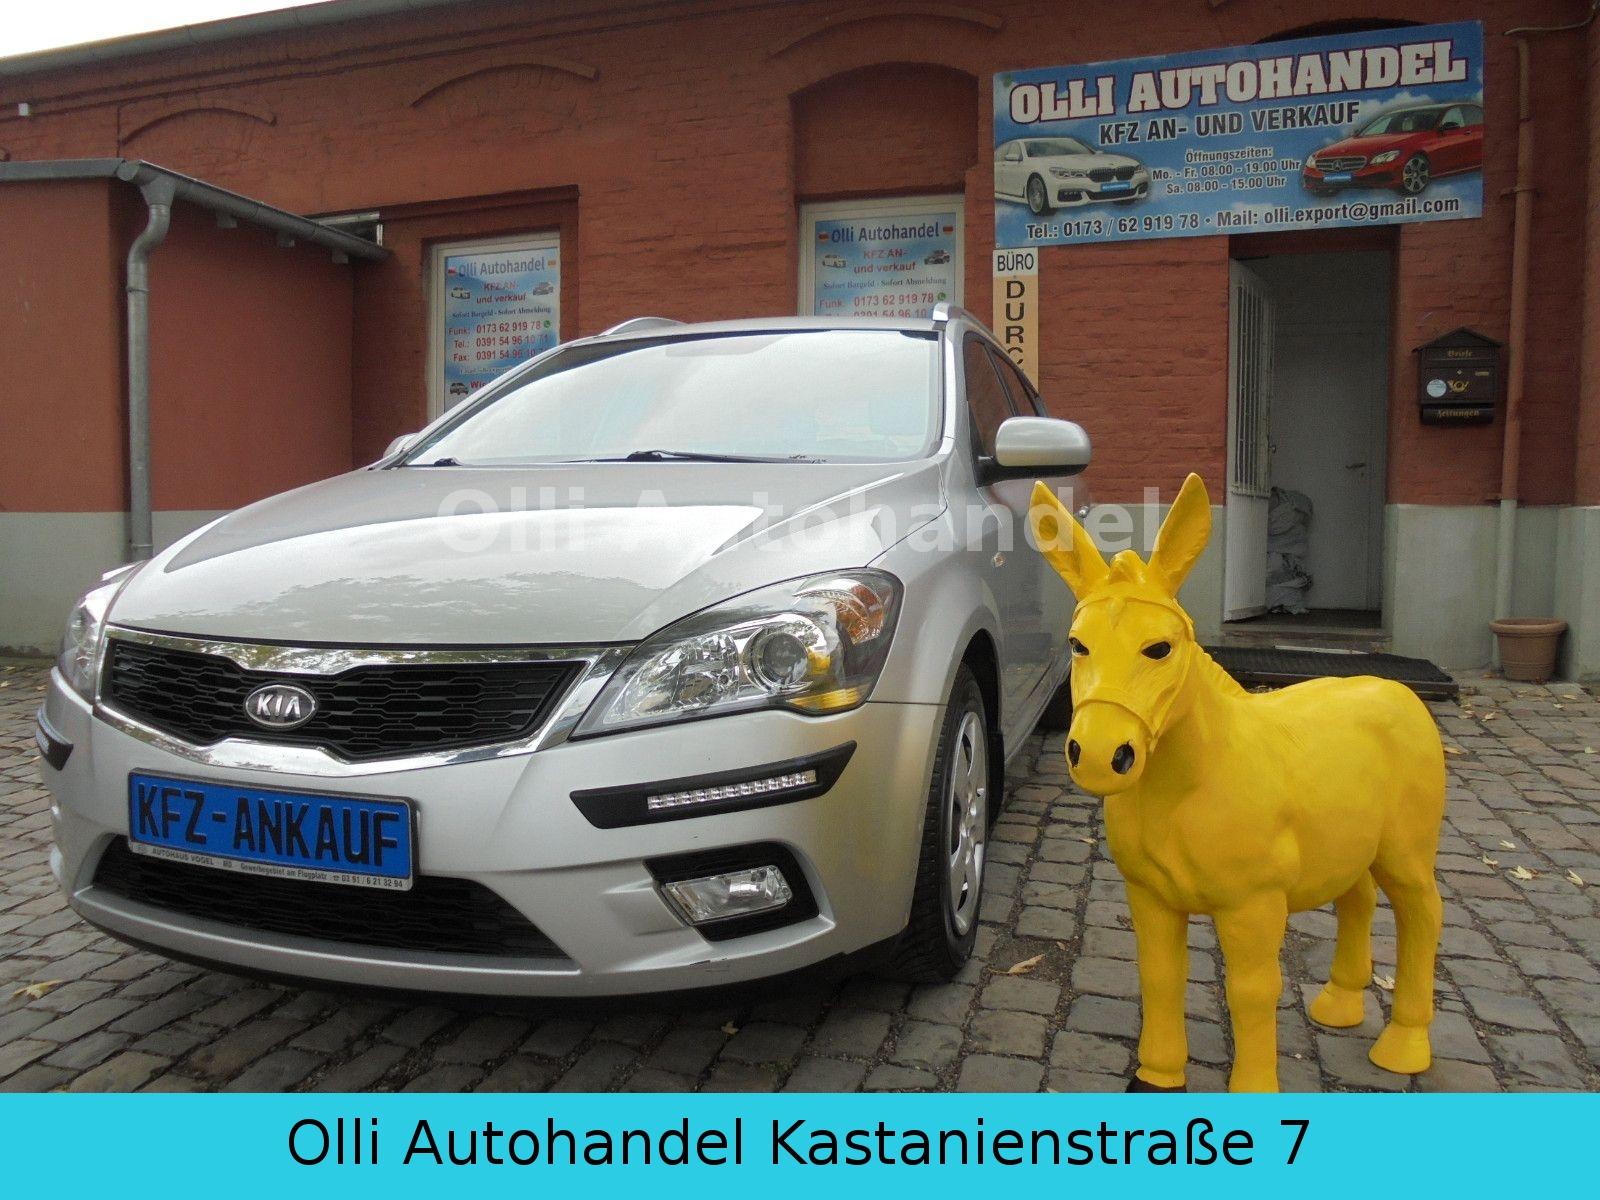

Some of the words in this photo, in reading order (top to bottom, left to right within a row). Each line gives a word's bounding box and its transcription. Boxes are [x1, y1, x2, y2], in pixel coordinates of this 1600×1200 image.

[1009, 72, 1114, 125] OLLI
[1127, 40, 1467, 113] AUTOHANDEL
[1099, 121, 1139, 145] KFZ
[1147, 117, 1188, 142] AN-
[1195, 113, 1243, 138] UND
[1251, 101, 1360, 133] VERKAUF
[1186, 147, 1273, 163] Öffnungszeiten:
[1152, 169, 1173, 180] Mo.
[1184, 167, 1197, 178] Fr.
[1201, 164, 1232, 177] 08.00
[1246, 160, 1277, 173] 19.00
[1281, 159, 1300, 170] Uhr
[1187, 180, 1218, 193] 08.00
[1231, 178, 1262, 190] 15.00
[1266, 176, 1286, 187] Uhr
[1026, 224, 1059, 240] Tel.:
[1063, 220, 1102, 238] 0173
[1105, 220, 1114, 237] /
[1118, 218, 1138, 234] 62
[1143, 216, 1174, 232] 919
[1179, 214, 1199, 230] 78
[1217, 209, 1258, 228] Mail:
[1264, 197, 1460, 225] olli.export@gmail.com
[831, 226, 854, 243] Olli
[858, 221, 940, 242] Autohandel
[863, 250, 884, 259] KFZ
[997, 251, 1034, 271] BÜRO
[480, 256, 545, 276] Autohandel
[853, 262, 874, 274] und
[877, 260, 917, 273] verkauf
[476, 294, 491, 304] und
[853, 295, 879, 307] 0173
[883, 294, 895, 306] 62
[898, 293, 918, 304] 919
[921, 292, 934, 303] 78
[476, 324, 497, 334] 0173
[499, 323, 510, 333] 62
[512, 322, 528, 332] 919
[529, 320, 542, 330] 78
[476, 337, 496, 347] 0391
[499, 336, 510, 346] 54
[512, 335, 523, 345] 96
[453, 352, 470, 362] Fax:
[476, 350, 496, 360] 0391
[499, 350, 510, 359] 54
[257, 693, 301, 718] KIA
[138, 782, 399, 866] KFZ-ANKAUF
[190, 854, 214, 866] VOGEL
